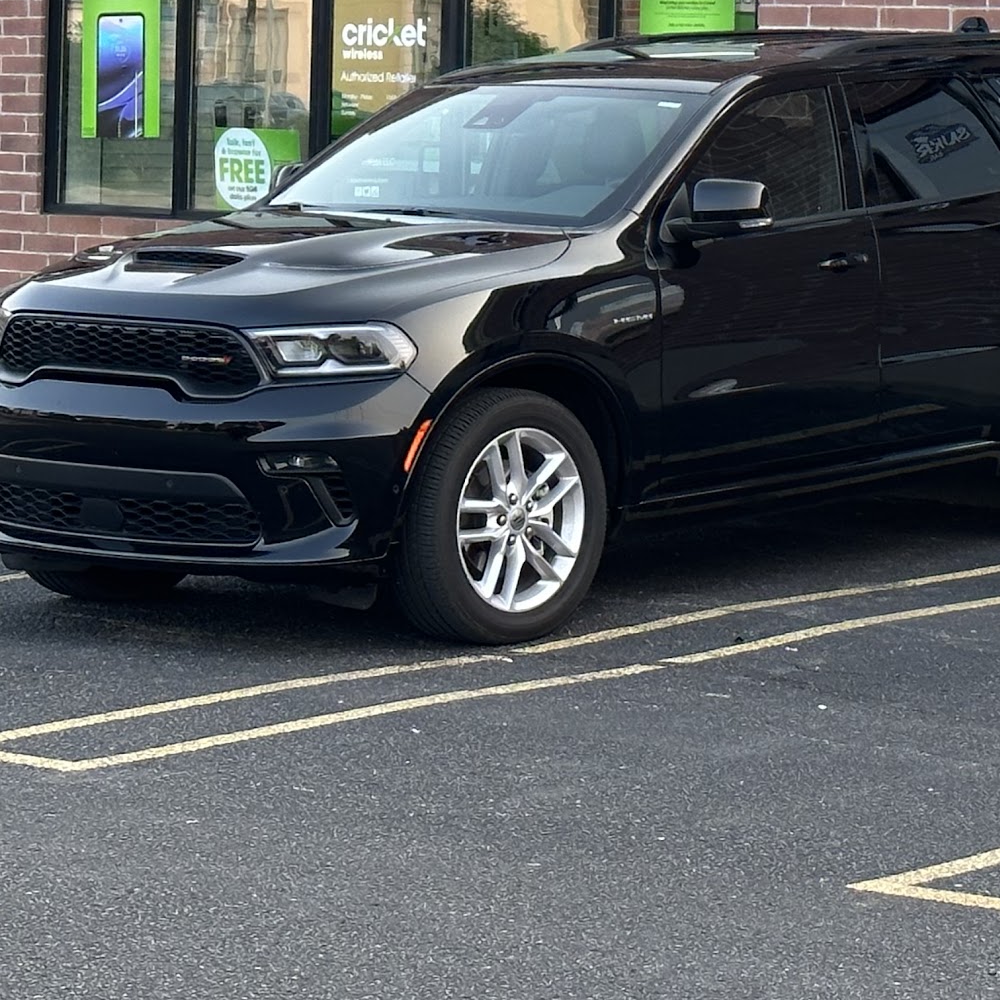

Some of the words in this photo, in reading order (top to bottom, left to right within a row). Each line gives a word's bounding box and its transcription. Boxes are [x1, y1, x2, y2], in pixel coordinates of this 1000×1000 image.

[341, 17, 427, 47] cricket
[342, 47, 384, 60] wireless
[340, 70, 385, 83] Authorized
[219, 157, 266, 185] FREE
